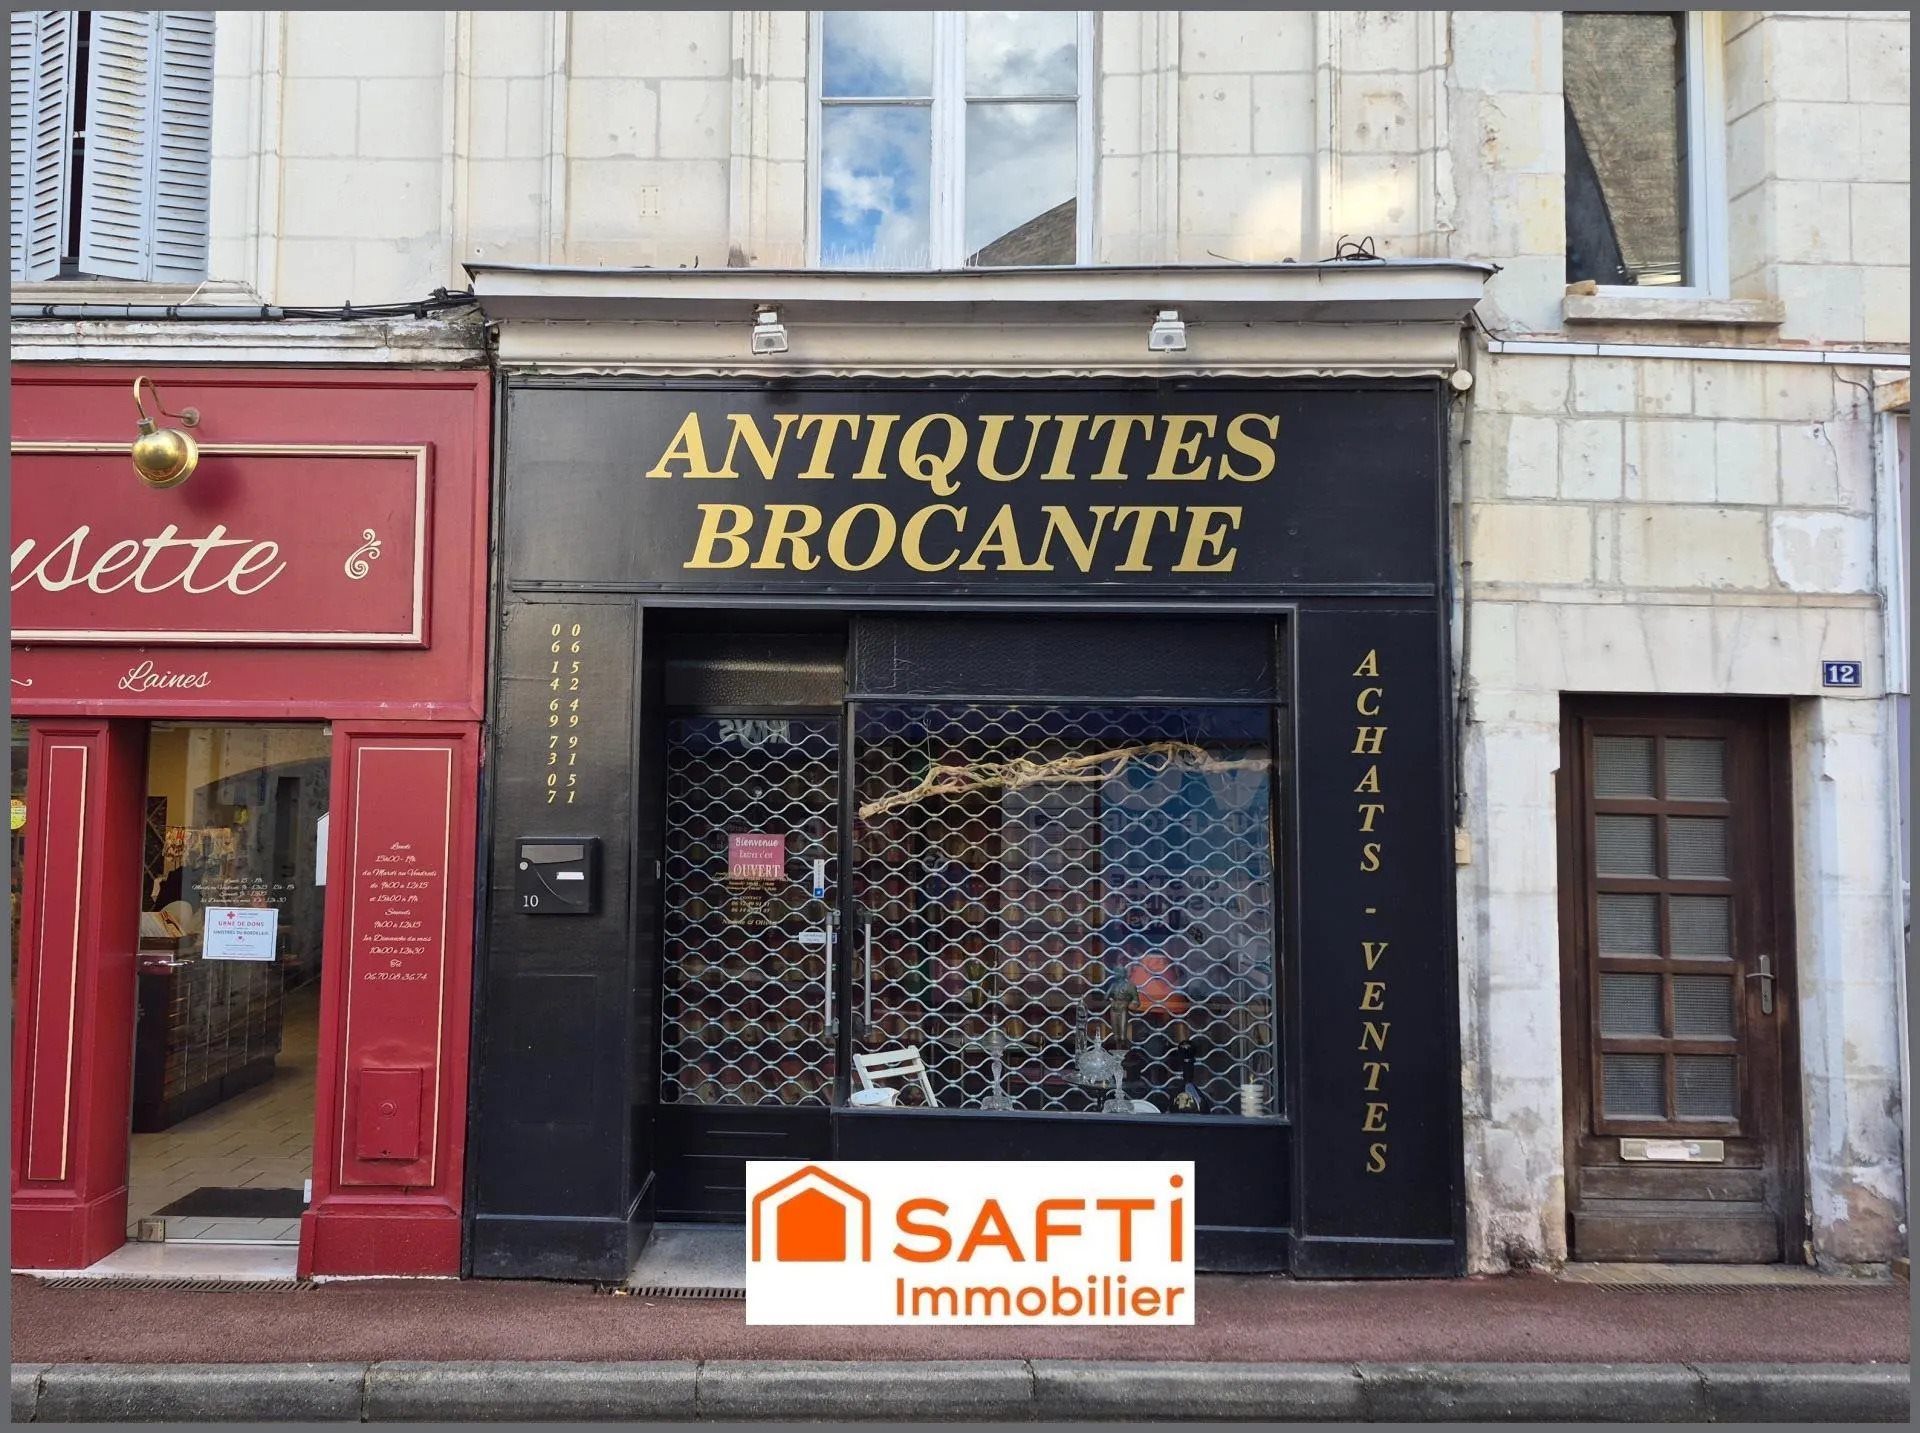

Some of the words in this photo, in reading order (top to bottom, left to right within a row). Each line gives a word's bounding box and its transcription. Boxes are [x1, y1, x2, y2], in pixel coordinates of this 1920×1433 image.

[645, 411, 1280, 497] ANTIQUITES
[683, 502, 1243, 573] BROCANTE
[118, 660, 211, 692] Laines
[1829, 665, 1854, 683] 12
[1352, 649, 1387, 872] ACHATS
[735, 837, 778, 847] Bienvenue
[733, 863, 781, 878] OUVERT
[522, 894, 539, 908] 10
[1358, 941, 1391, 1173] VENTES
